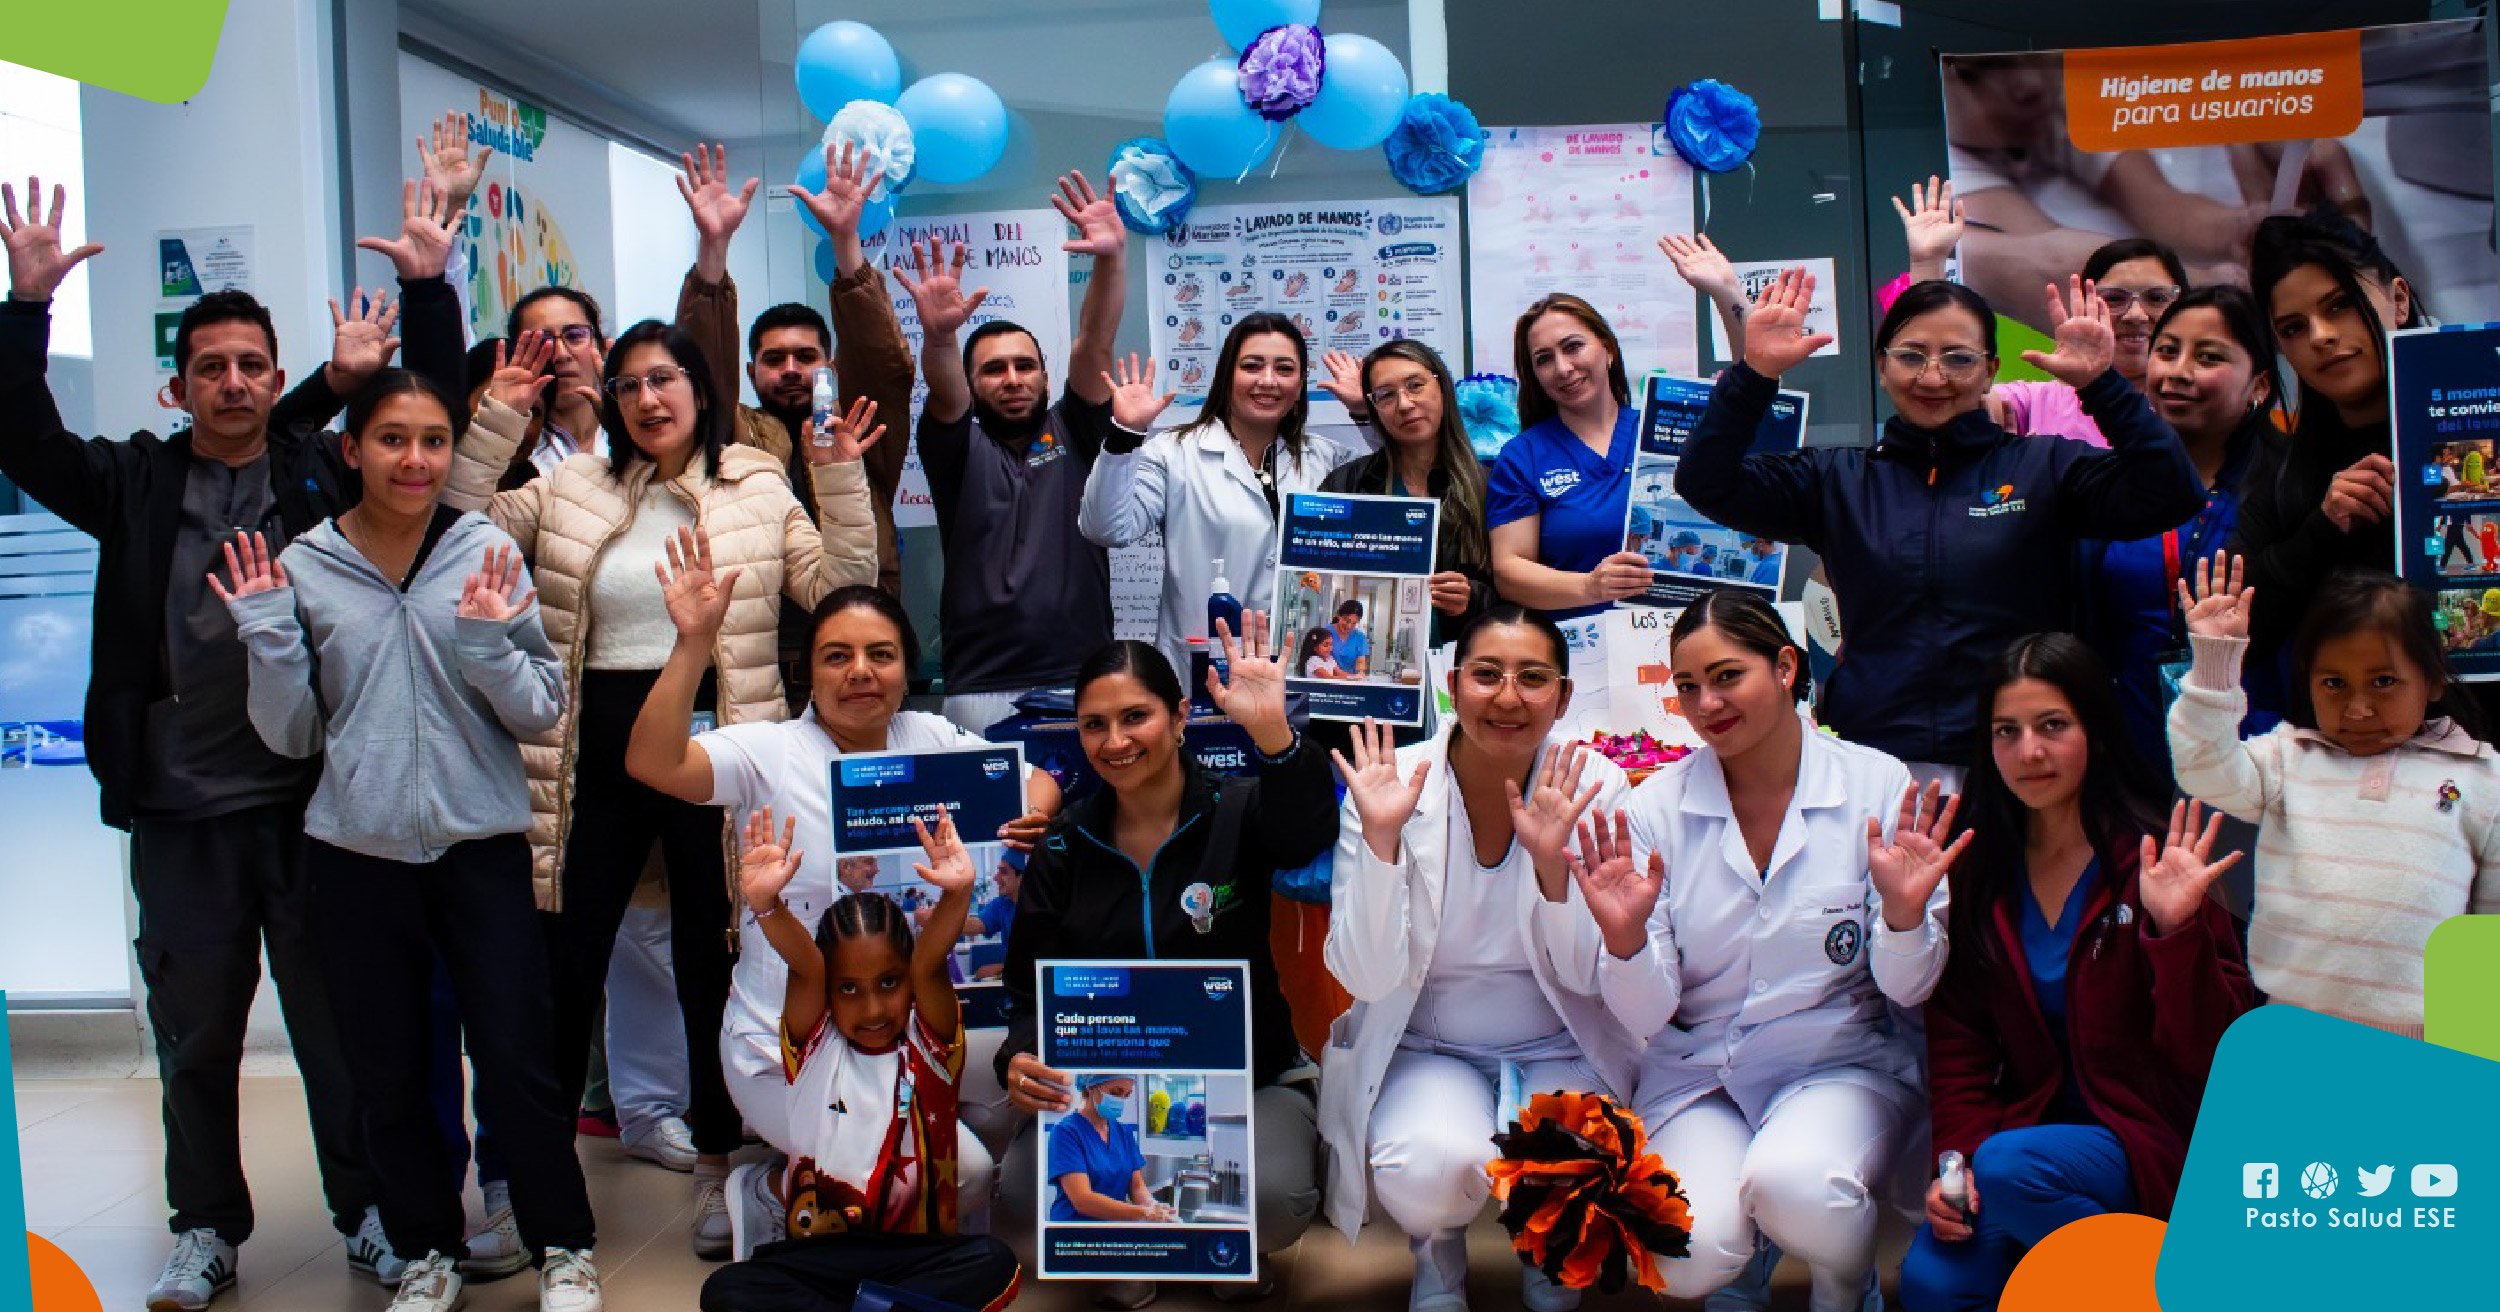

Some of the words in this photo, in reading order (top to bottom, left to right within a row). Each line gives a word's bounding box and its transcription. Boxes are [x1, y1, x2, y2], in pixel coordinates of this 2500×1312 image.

[2101, 75, 2192, 102] Higiene
[2200, 69, 2231, 91] de
[2240, 68, 2323, 88] manos
[2112, 103, 2179, 131] para
[2190, 92, 2313, 120] usuarios
[1246, 212, 1294, 233] LAVADO
[1297, 212, 1313, 226] DE
[1317, 211, 1362, 227] MANOS
[993, 222, 1021, 241] DEL
[986, 246, 1041, 270] MANOS
[2431, 389, 2441, 401] 5
[2447, 387, 2500, 400] mome
[2429, 405, 2445, 417] te
[1197, 750, 1247, 768] west
[848, 806, 865, 817] Tan
[914, 803, 944, 813] com
[946, 801, 960, 811] un
[847, 815, 887, 828] saludo,
[1056, 1012, 1085, 1024] Cada
[1087, 1014, 1136, 1026] persona
[1055, 1026, 1077, 1037] que
[1097, 1037, 1145, 1048] persona
[1148, 1037, 1171, 1048] que
